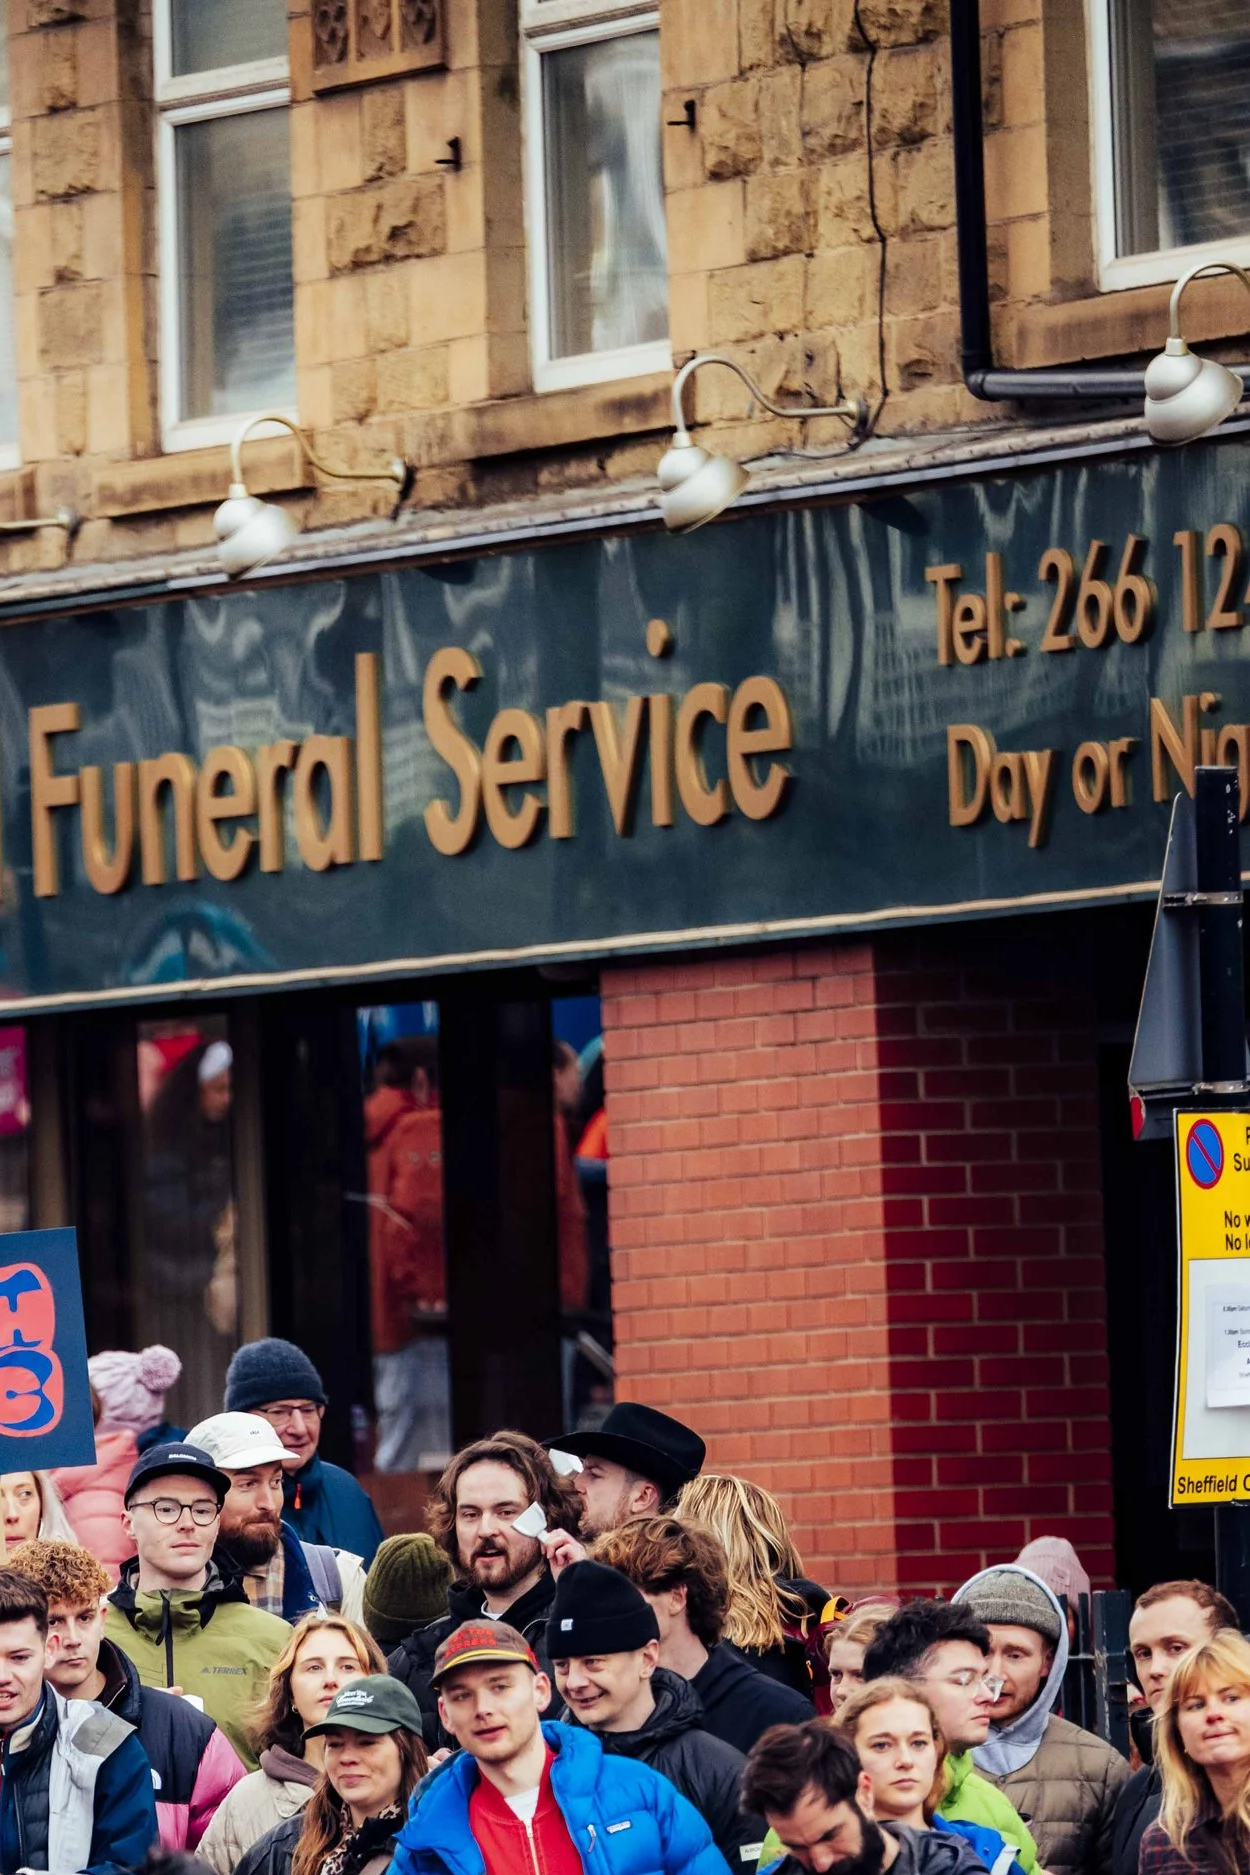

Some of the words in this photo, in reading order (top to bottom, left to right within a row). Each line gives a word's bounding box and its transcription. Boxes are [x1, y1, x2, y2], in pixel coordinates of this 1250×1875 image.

[924, 551, 1026, 666] Tel:
[1038, 532, 1153, 652] 266
[1173, 523, 1250, 634] 12
[29, 652, 384, 898] Funeral
[423, 618, 793, 857] Service
[946, 724, 1052, 849] Day
[1072, 738, 1140, 814] or
[1224, 1210, 1241, 1228] No
[1225, 1233, 1242, 1251] No
[1177, 1474, 1238, 1495] Sheffield
[213, 1666, 247, 1675] TERREX
